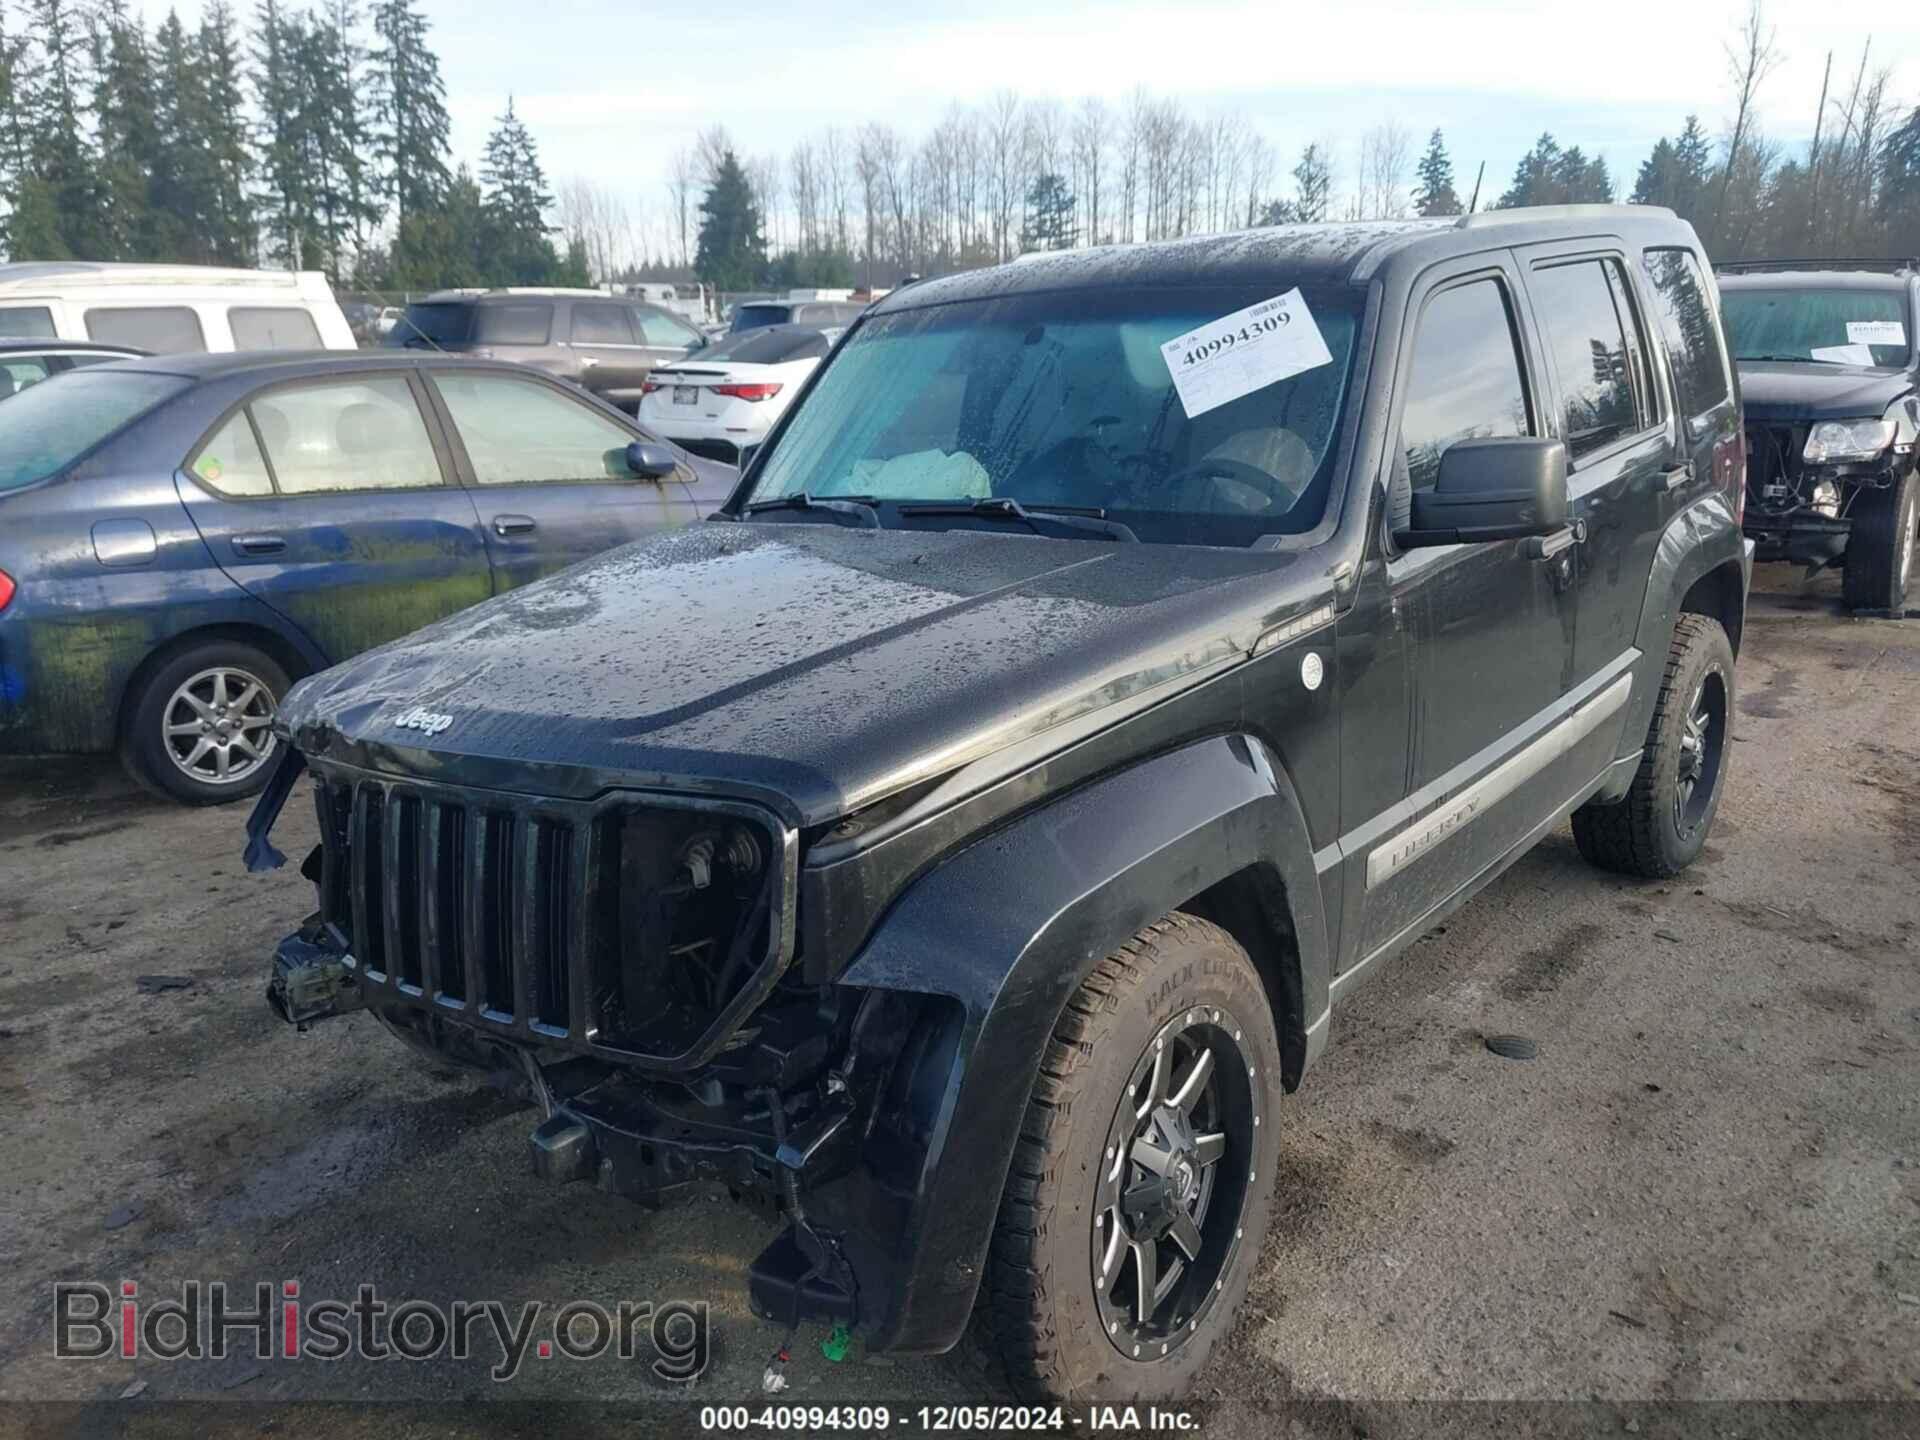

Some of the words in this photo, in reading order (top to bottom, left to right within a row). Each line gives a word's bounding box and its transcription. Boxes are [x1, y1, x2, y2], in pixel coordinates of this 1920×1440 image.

[1182, 311, 1292, 367] 40994309
[395, 706, 454, 737] Jeep
[1391, 793, 1481, 868] LIBERTY
